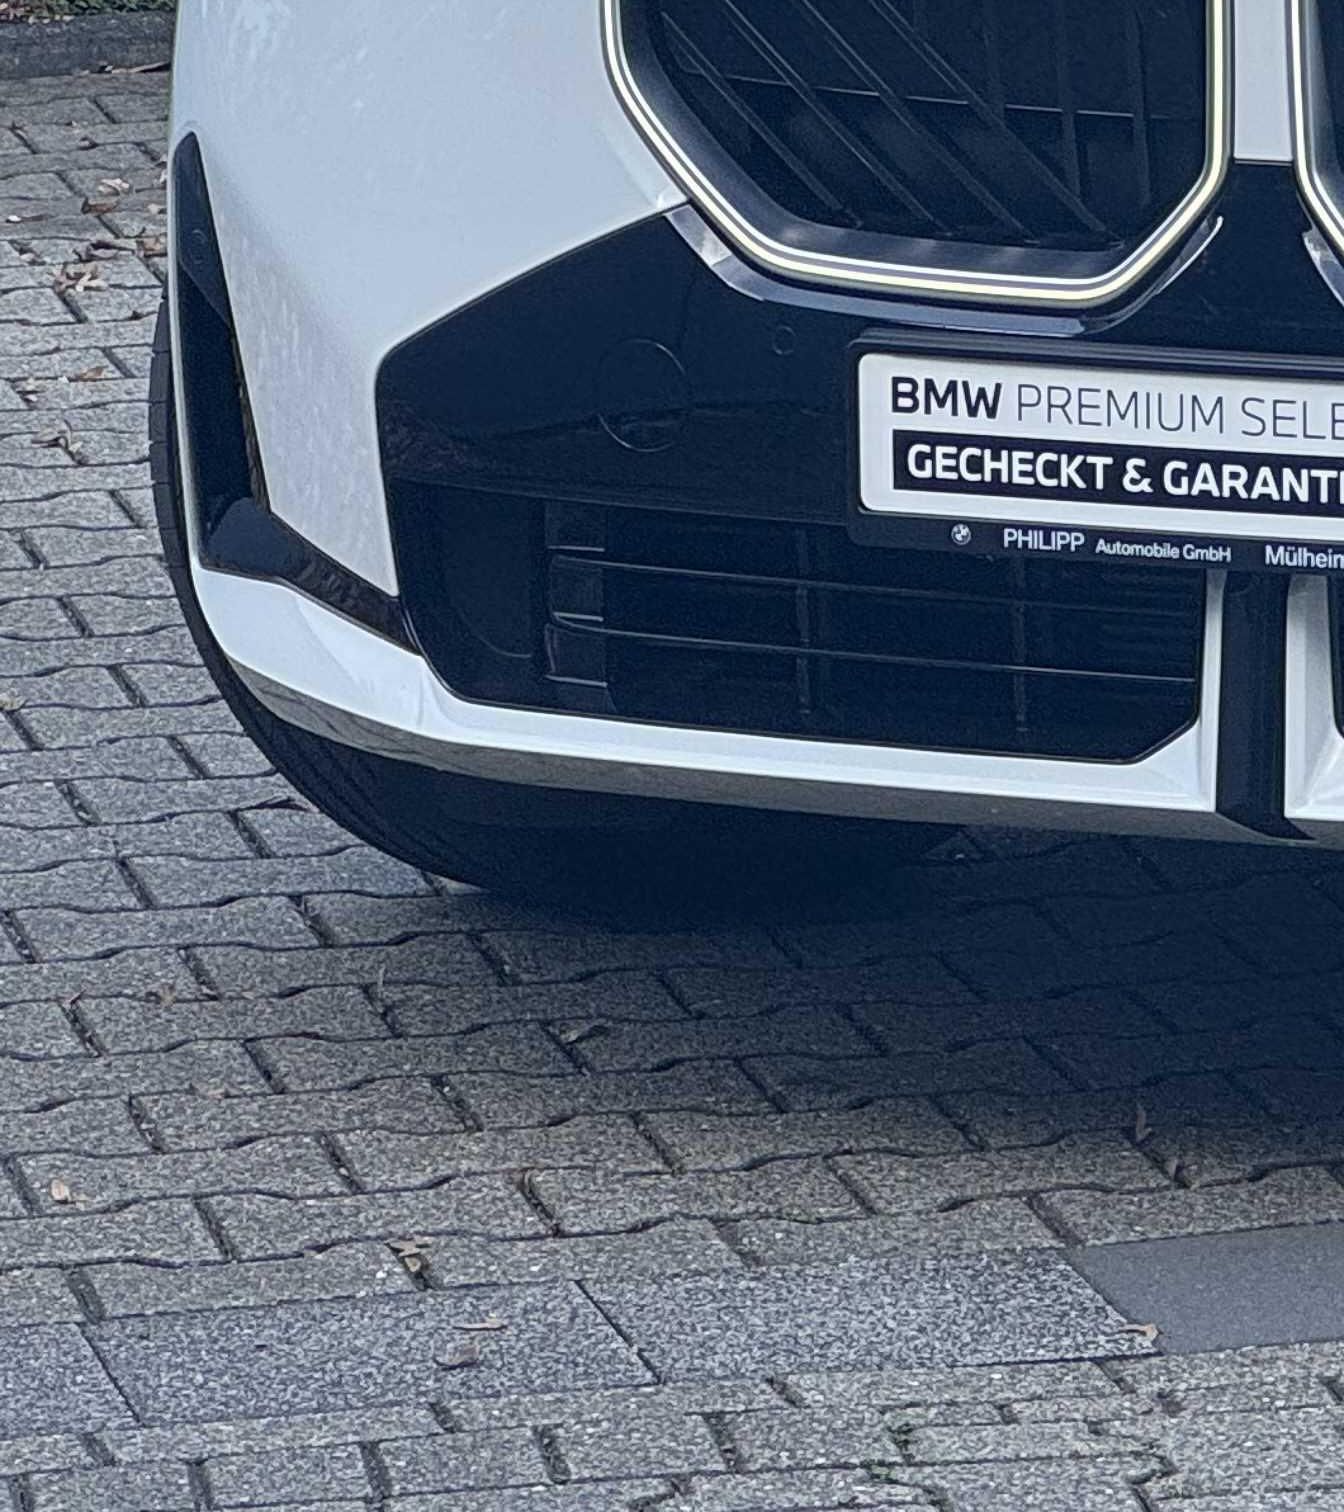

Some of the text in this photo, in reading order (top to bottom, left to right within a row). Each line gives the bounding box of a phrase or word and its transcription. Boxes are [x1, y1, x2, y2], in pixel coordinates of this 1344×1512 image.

[891, 375, 1002, 420] BMW
[1016, 383, 1225, 435] PREMIUM
[906, 443, 1114, 491] GECHECKT
[1121, 457, 1154, 494] &
[1002, 527, 1232, 563] PHILIPP Automobile GmbH
